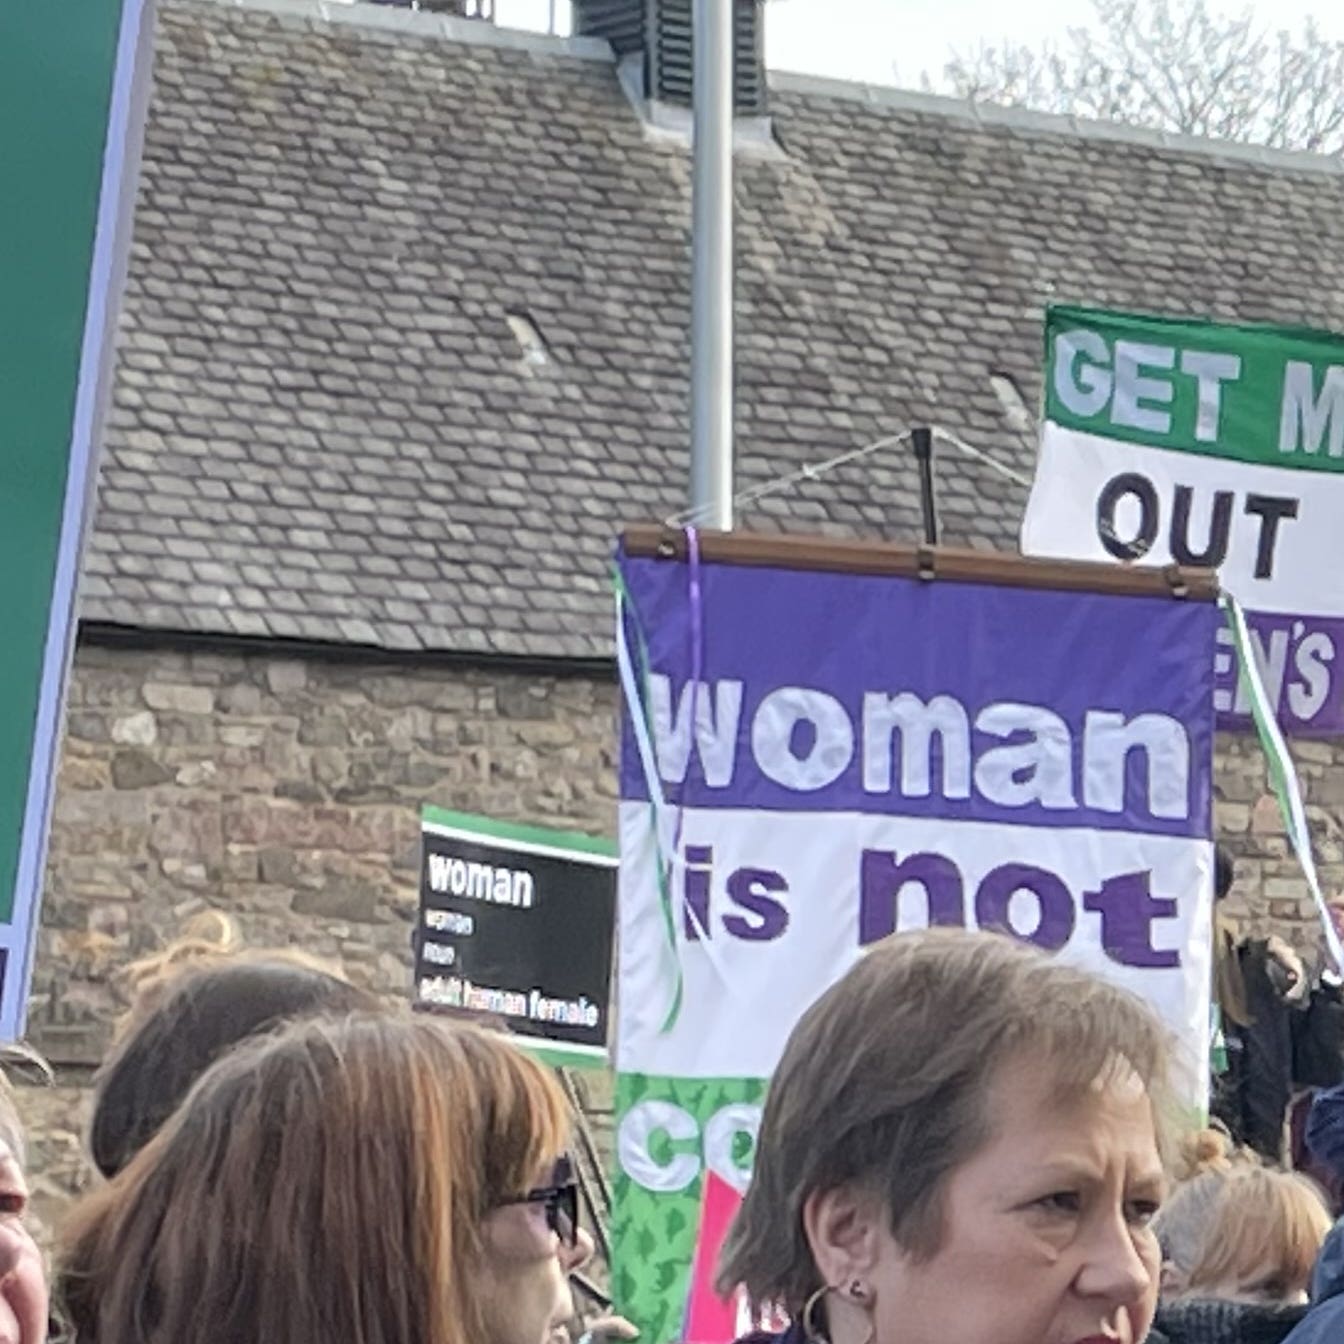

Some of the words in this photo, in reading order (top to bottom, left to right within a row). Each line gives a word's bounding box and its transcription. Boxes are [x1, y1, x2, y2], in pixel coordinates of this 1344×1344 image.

[1052, 329, 1240, 442] GET
[1097, 472, 1297, 579] OUT
[651, 674, 1191, 818] woman
[429, 853, 534, 907] woman
[685, 846, 789, 941] is
[859, 848, 1180, 967] not
[530, 989, 599, 1026] female
